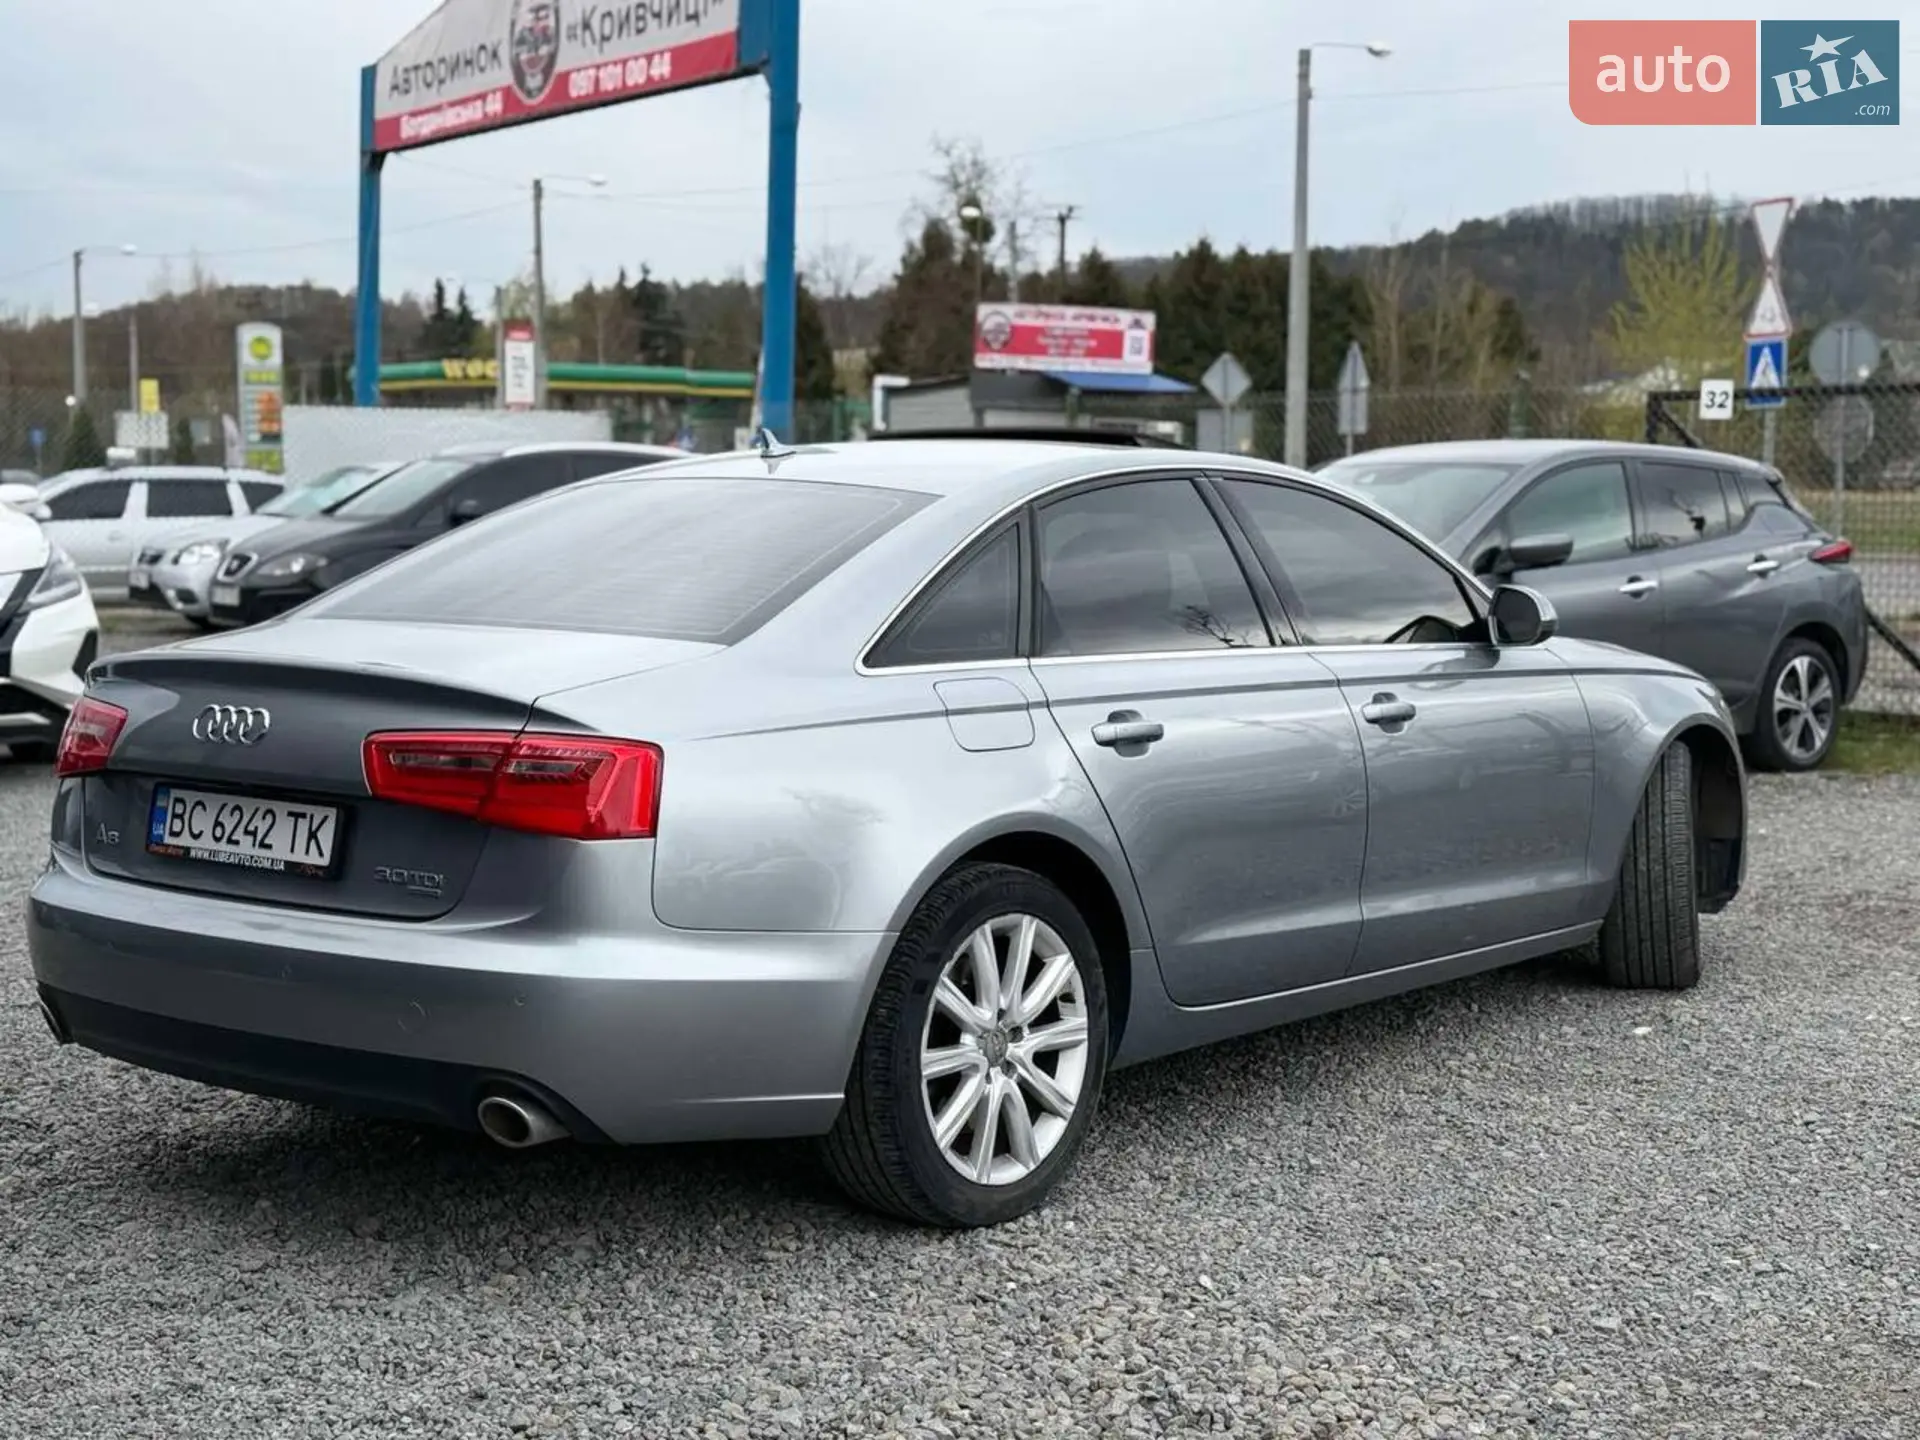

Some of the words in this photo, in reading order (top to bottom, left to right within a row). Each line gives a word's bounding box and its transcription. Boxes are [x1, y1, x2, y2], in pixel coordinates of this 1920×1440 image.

[388, 38, 502, 100] Авторинок
[566, 0, 724, 53] «Кривчиц
[568, 67, 596, 98] 097
[625, 57, 648, 87] 00
[650, 51, 672, 81] 44
[1705, 391, 1730, 409] 32
[168, 797, 207, 840] BC
[211, 802, 277, 851] 6242
[287, 811, 329, 858] TK
